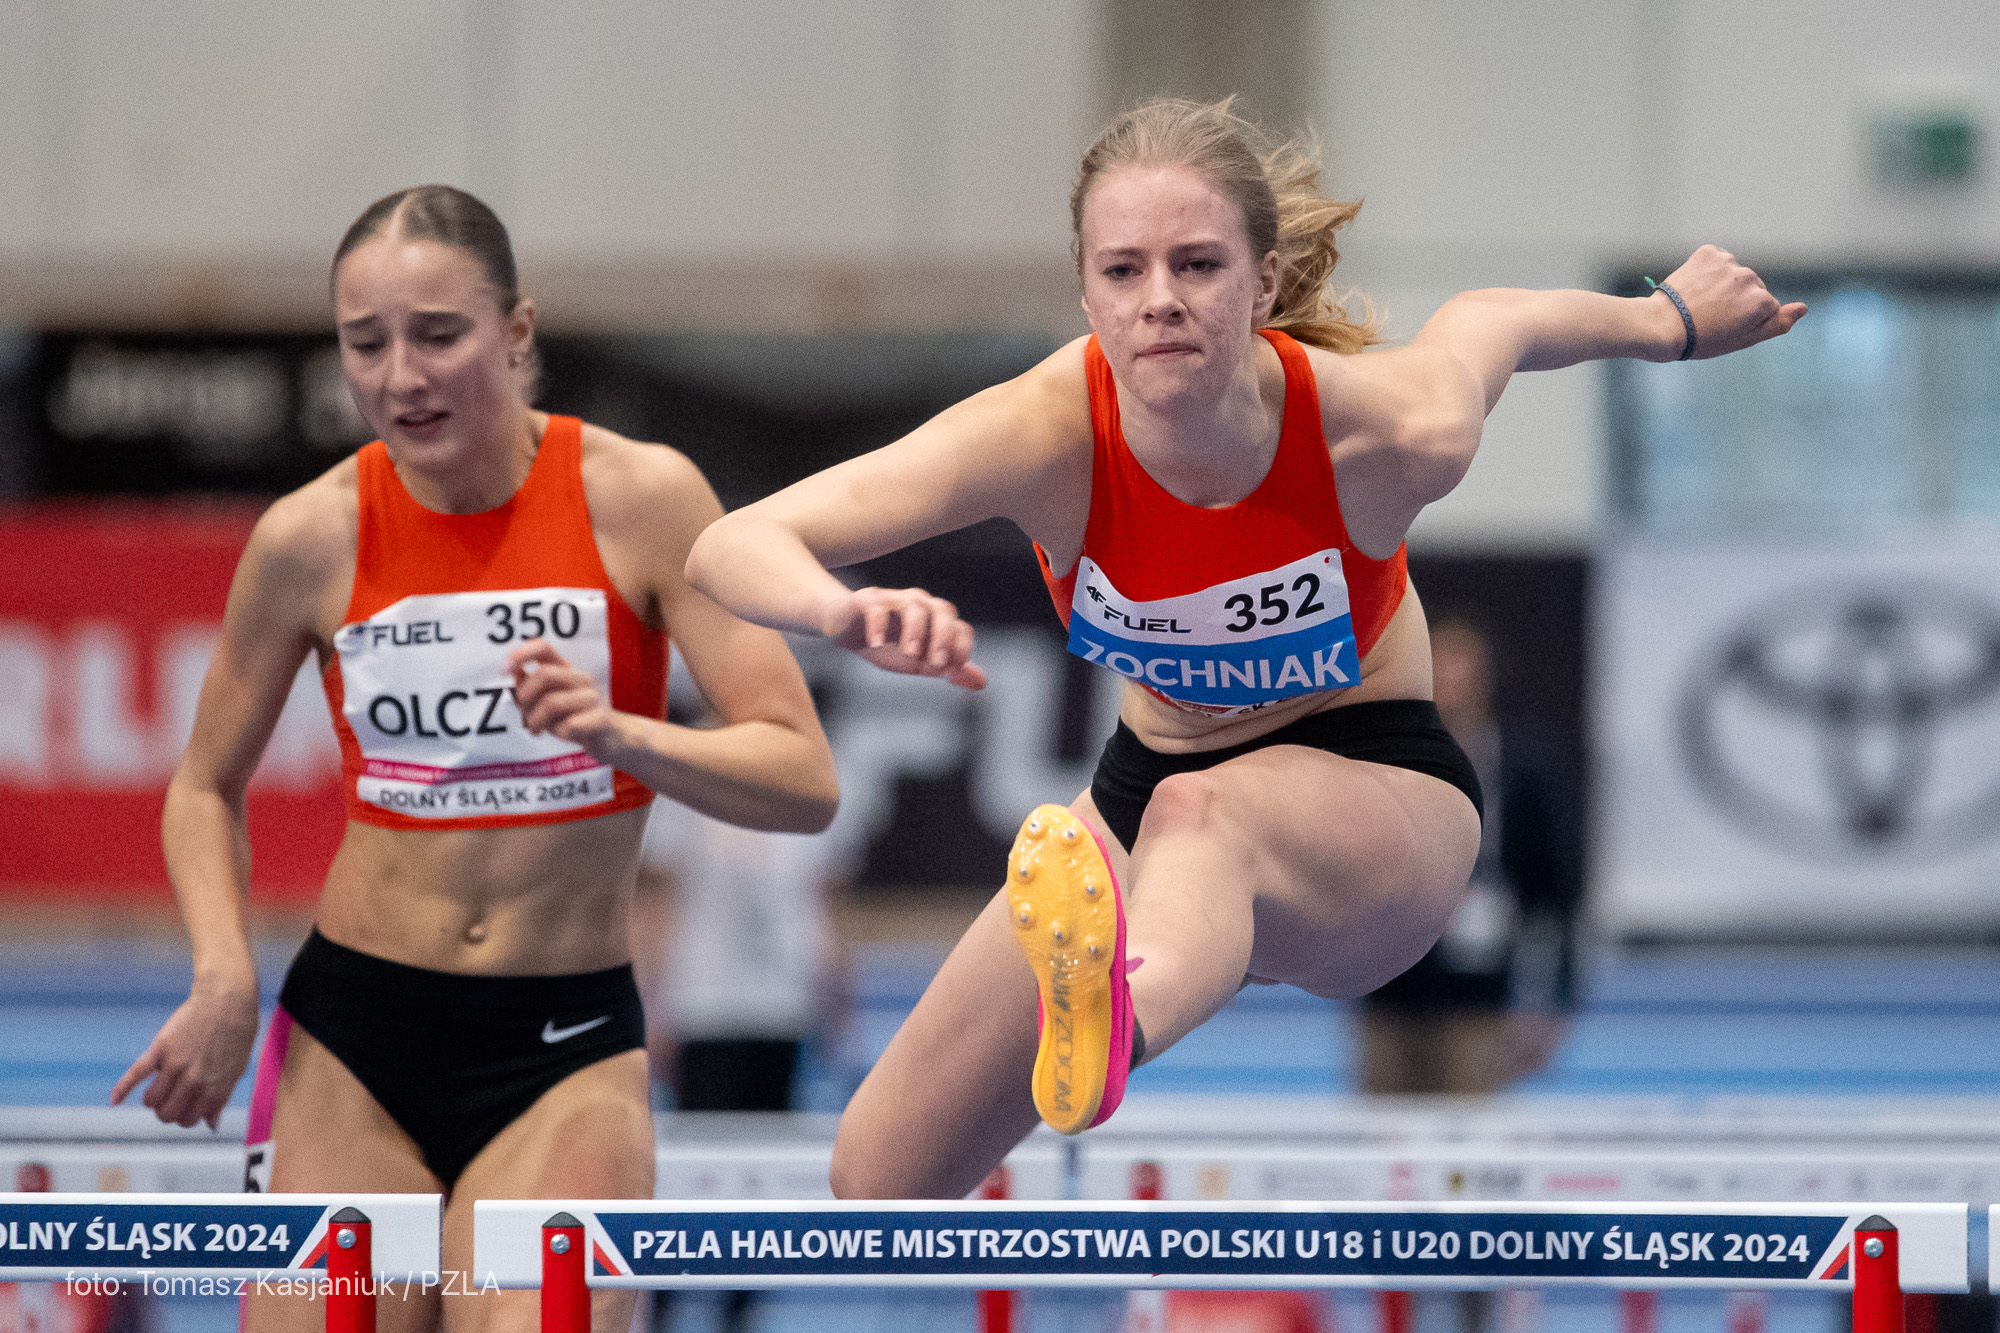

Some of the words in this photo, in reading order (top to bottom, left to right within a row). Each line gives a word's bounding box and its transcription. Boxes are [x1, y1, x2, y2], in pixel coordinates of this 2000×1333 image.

[486, 601, 580, 644] 350
[1103, 604, 1192, 634] FUEL
[1224, 572, 1325, 633] 352
[372, 620, 453, 647] FUEL
[1080, 636, 1350, 689] ZOCHNIAK
[368, 686, 518, 739] OLCZ
[379, 788, 449, 809] DOLNY
[458, 784, 528, 811] ŚLĄSK
[537, 779, 590, 802] 2024
[86, 1217, 196, 1259] ŚLĄSK
[205, 1224, 289, 1251] 2024
[633, 1230, 722, 1259] PZLA
[731, 1229, 883, 1259] HALOWE
[892, 1229, 1152, 1258] MISTRZOSTWA
[1161, 1229, 1285, 1259] POLSKI
[1295, 1229, 1364, 1259] U18
[1373, 1230, 1381, 1259] i
[1392, 1230, 1461, 1259] U20
[1470, 1230, 1594, 1260] DOLNY
[1602, 1226, 1715, 1268] ŚLĄSK
[1722, 1233, 1810, 1263] 2024
